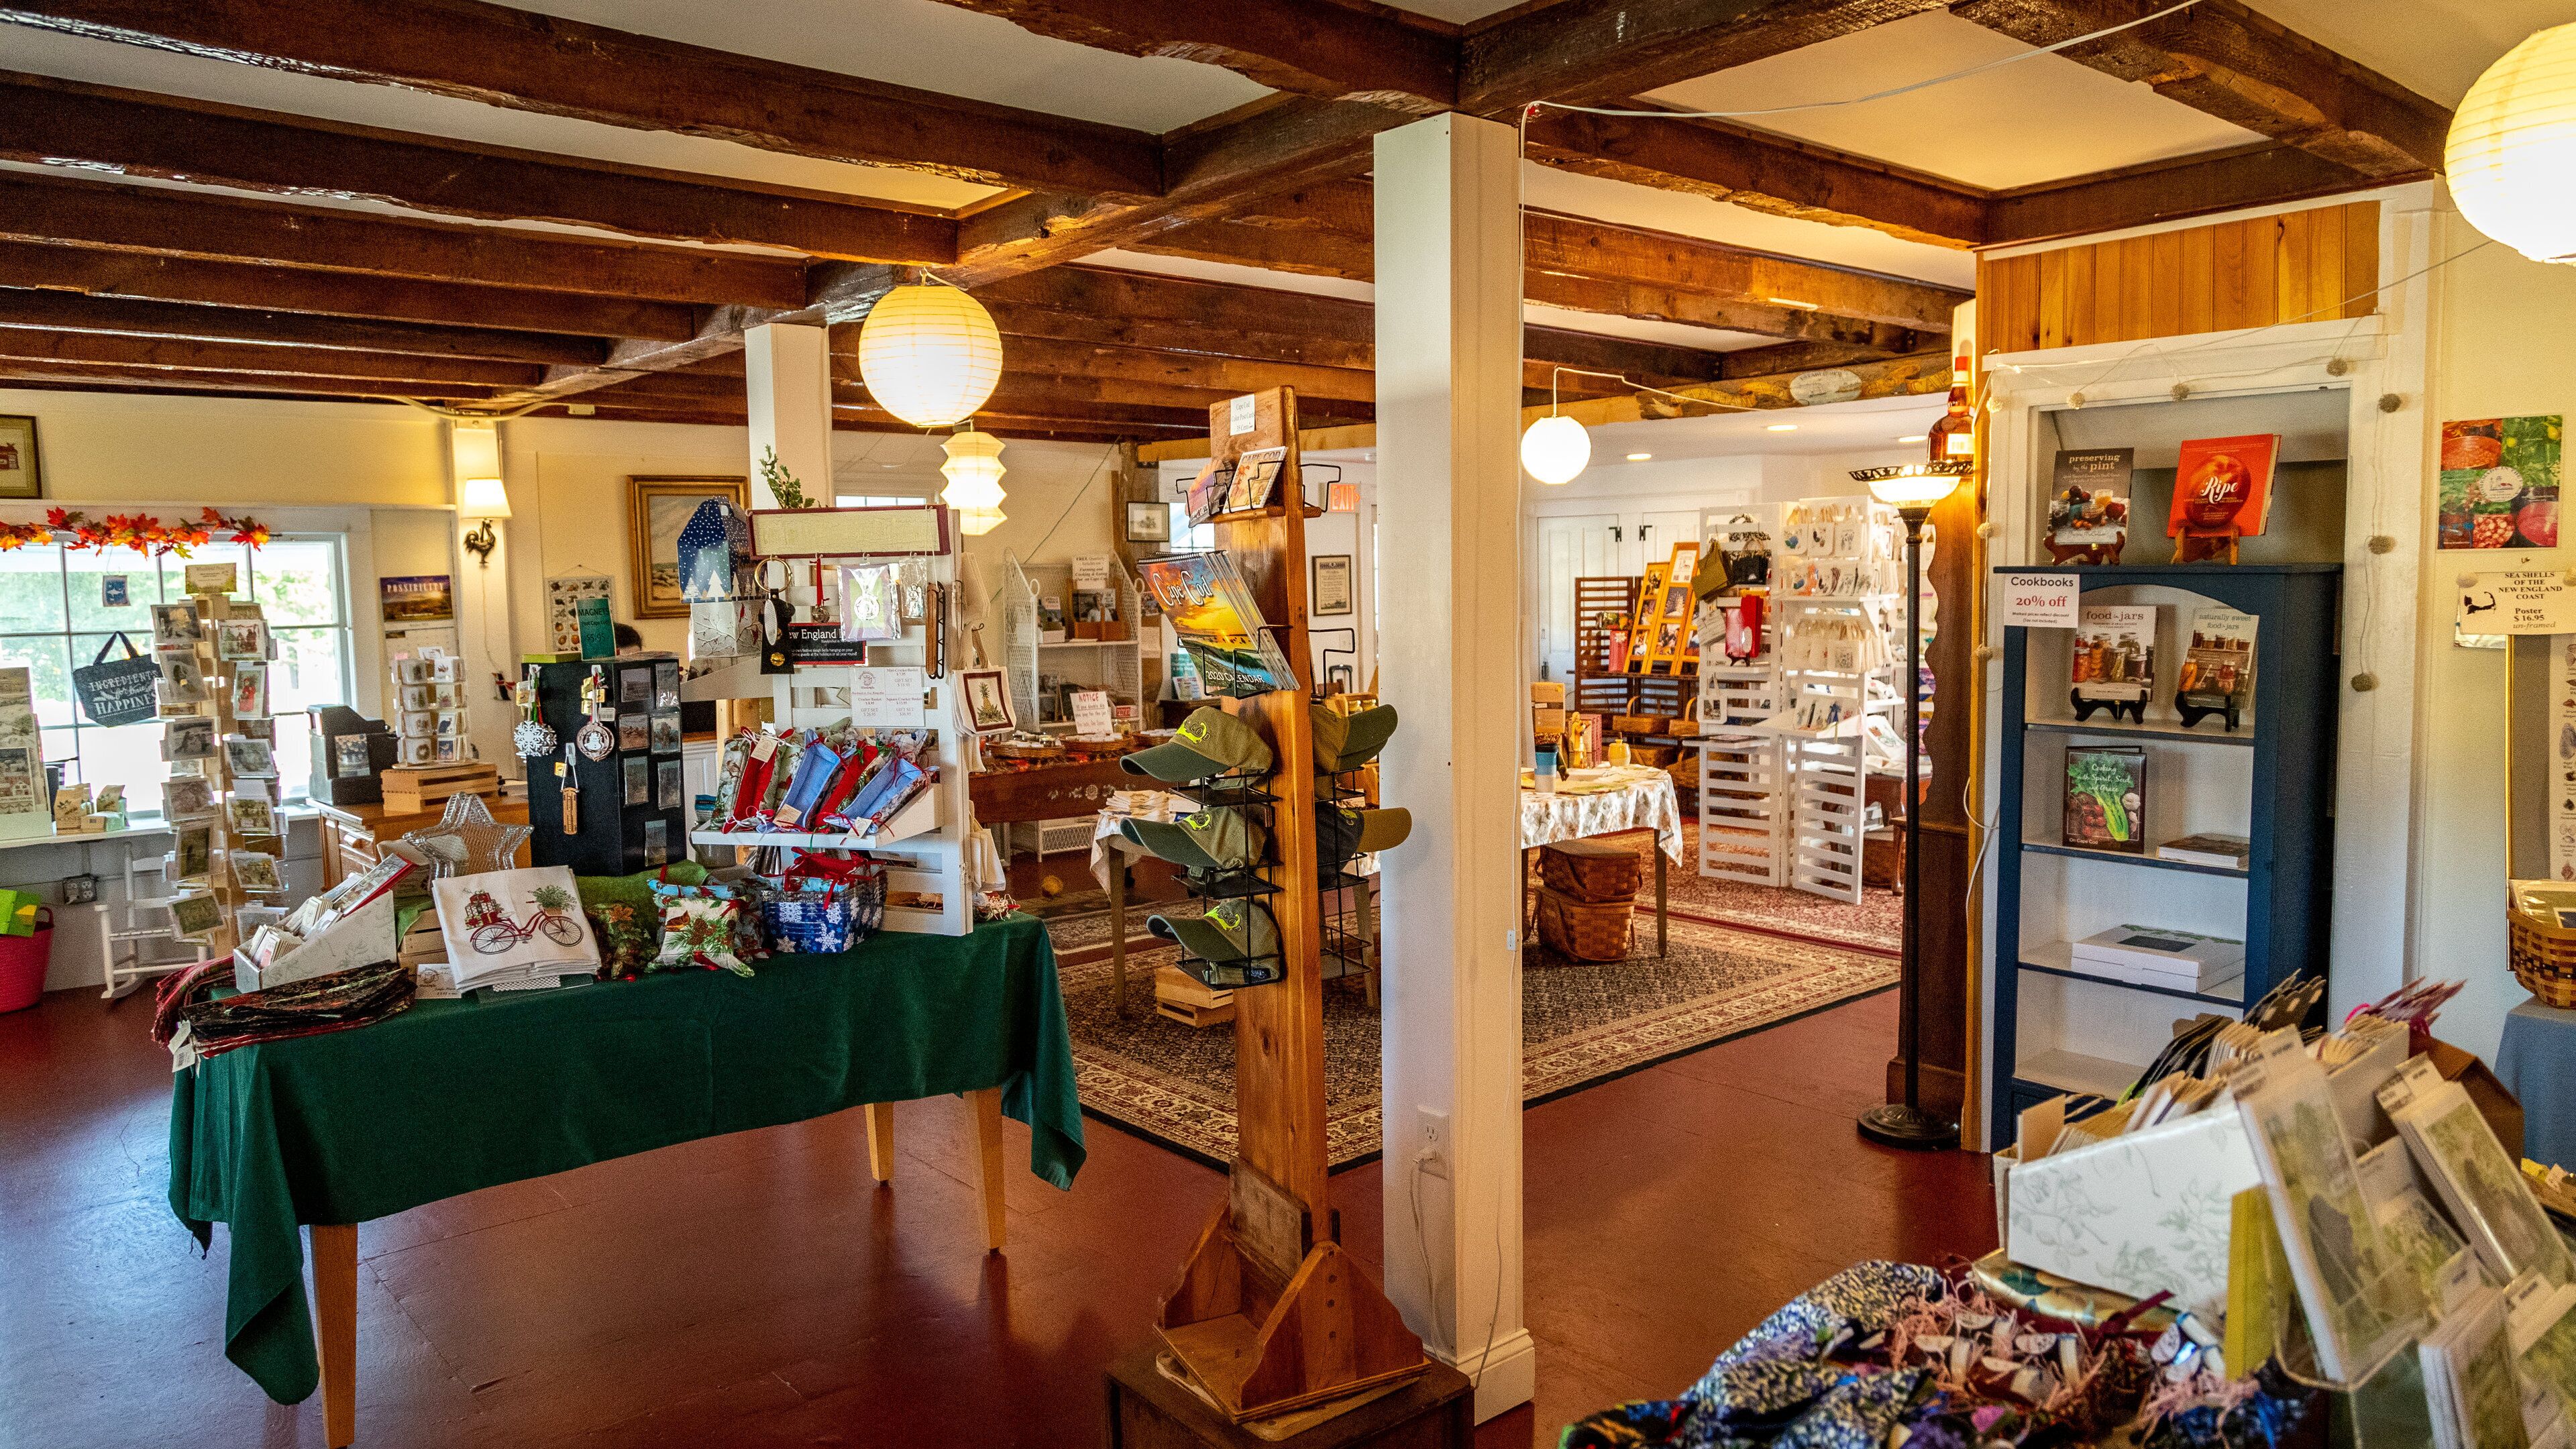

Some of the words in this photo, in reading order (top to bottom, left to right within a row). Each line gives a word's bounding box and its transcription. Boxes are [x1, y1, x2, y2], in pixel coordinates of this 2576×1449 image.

[1242, 454, 1260, 463] CAPE
[1263, 451, 1281, 460] COD
[2069, 454, 2121, 464] preserving
[2090, 462, 2115, 472] pint
[2200, 476, 2239, 504] Ripe
[1332, 485, 1356, 511] EXIT
[2011, 576, 2074, 587] Cookbooks
[387, 582, 444, 593] POSSIBILITY
[1152, 573, 1185, 606] Cape
[1181, 570, 1214, 606] Cod
[2016, 595, 2045, 607] 20%
[2049, 596, 2068, 607] off
[578, 608, 610, 616] MAGNETS
[2086, 611, 2112, 620] food
[2118, 611, 2144, 622] jars
[2199, 613, 2230, 622] naturally
[2513, 621, 2556, 630] un-framed
[789, 631, 799, 639] ew
[801, 629, 837, 641] England
[89, 669, 159, 692] INGREDIENTS
[1205, 671, 1225, 682] 2020
[1078, 692, 1099, 702] NOTICE
[95, 693, 157, 715] HAPPINES
[2092, 763, 2116, 775] Cooking
[2100, 784, 2119, 793] Grace
